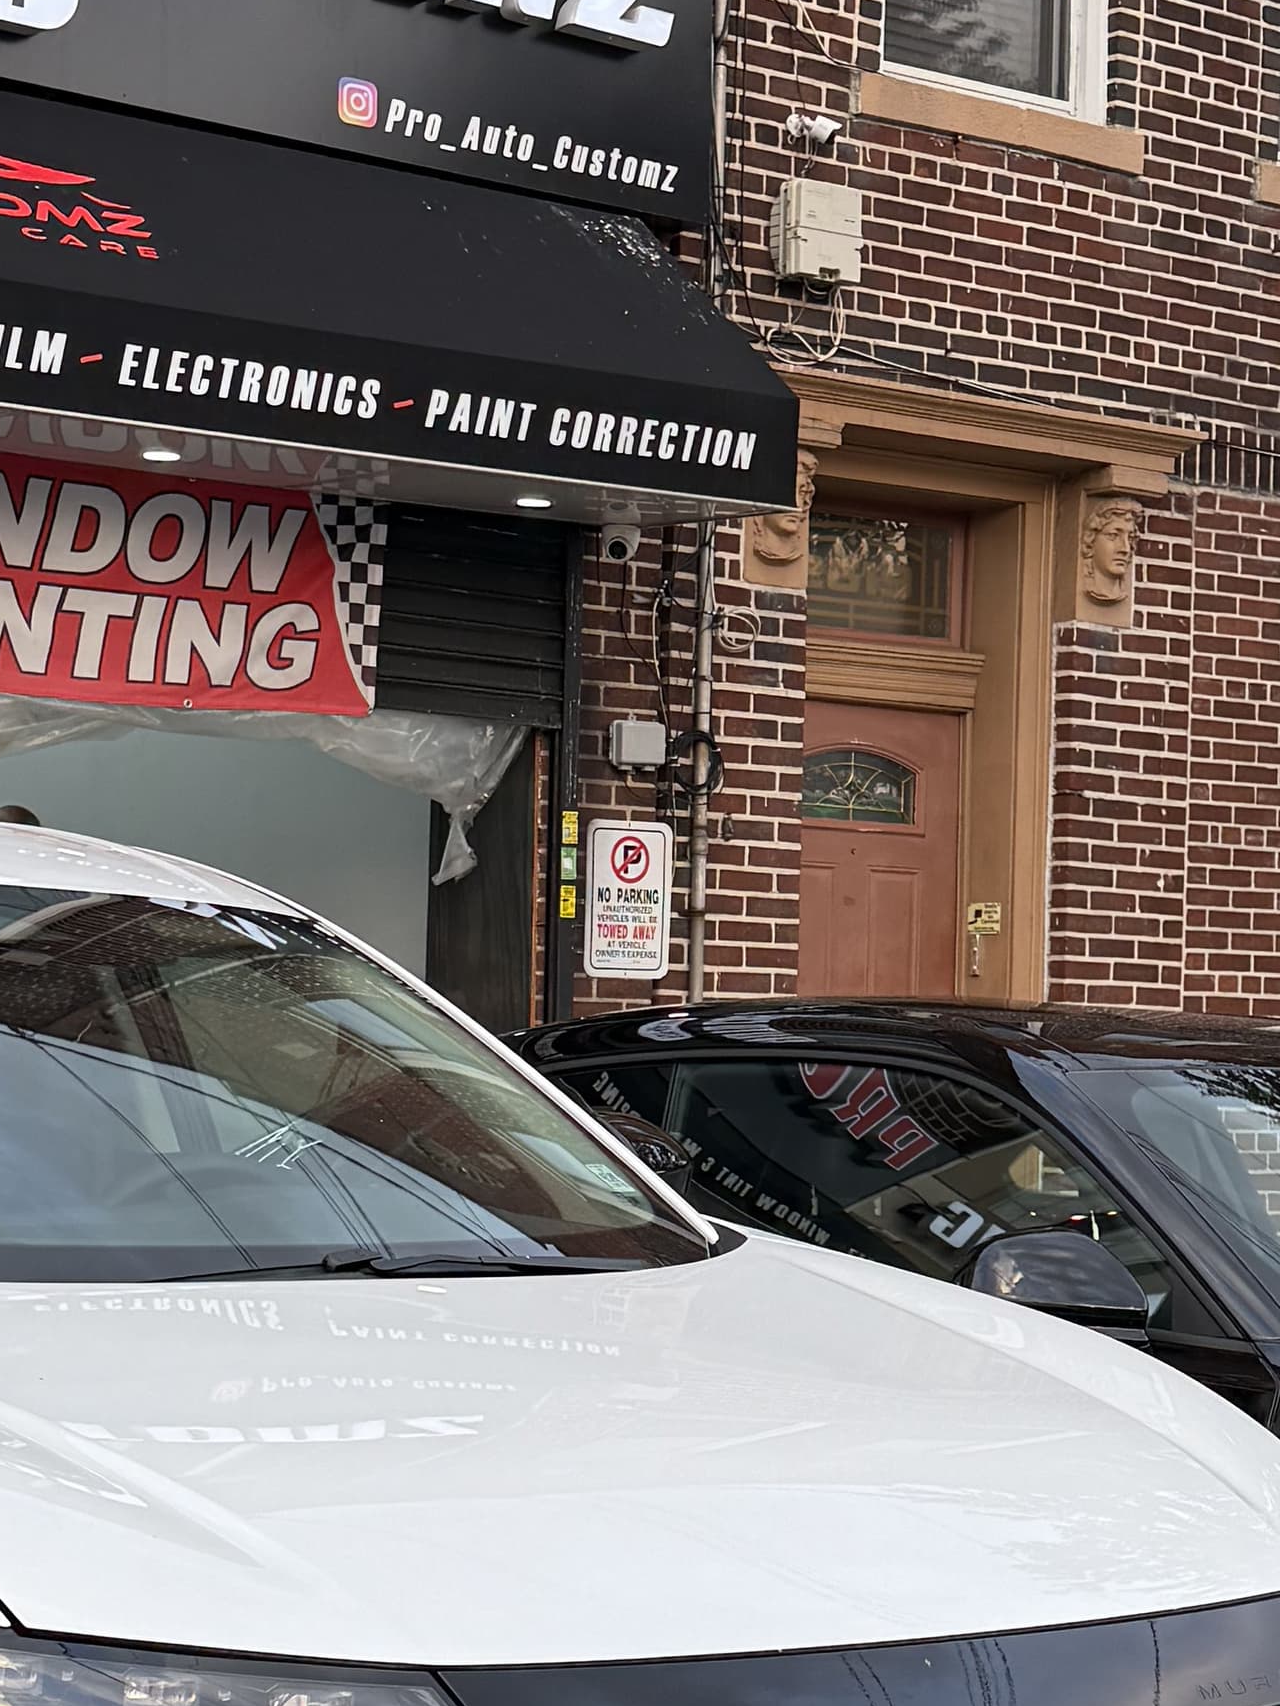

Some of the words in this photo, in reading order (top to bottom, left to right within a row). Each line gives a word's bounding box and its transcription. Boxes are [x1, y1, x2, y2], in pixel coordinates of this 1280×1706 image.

[384, 96, 679, 194] Pro_Auto_Customz
[21, 226, 160, 260] CARE
[118, 344, 381, 419] ELECTRONICS
[425, 388, 534, 443] PAINT
[548, 407, 756, 471] CORRECTION
[597, 887, 611, 903] NO
[617, 887, 659, 904] PARKING
[602, 905, 653, 914] UNAUTHORIZED
[597, 914, 629, 923] VEHICLES
[631, 915, 646, 923] WILL
[597, 923, 628, 939] TOWED
[632, 925, 657, 940] AWAY
[607, 940, 616, 948] AT
[618, 940, 647, 950] VEHICLE
[627, 950, 657, 959] EXPENSE
